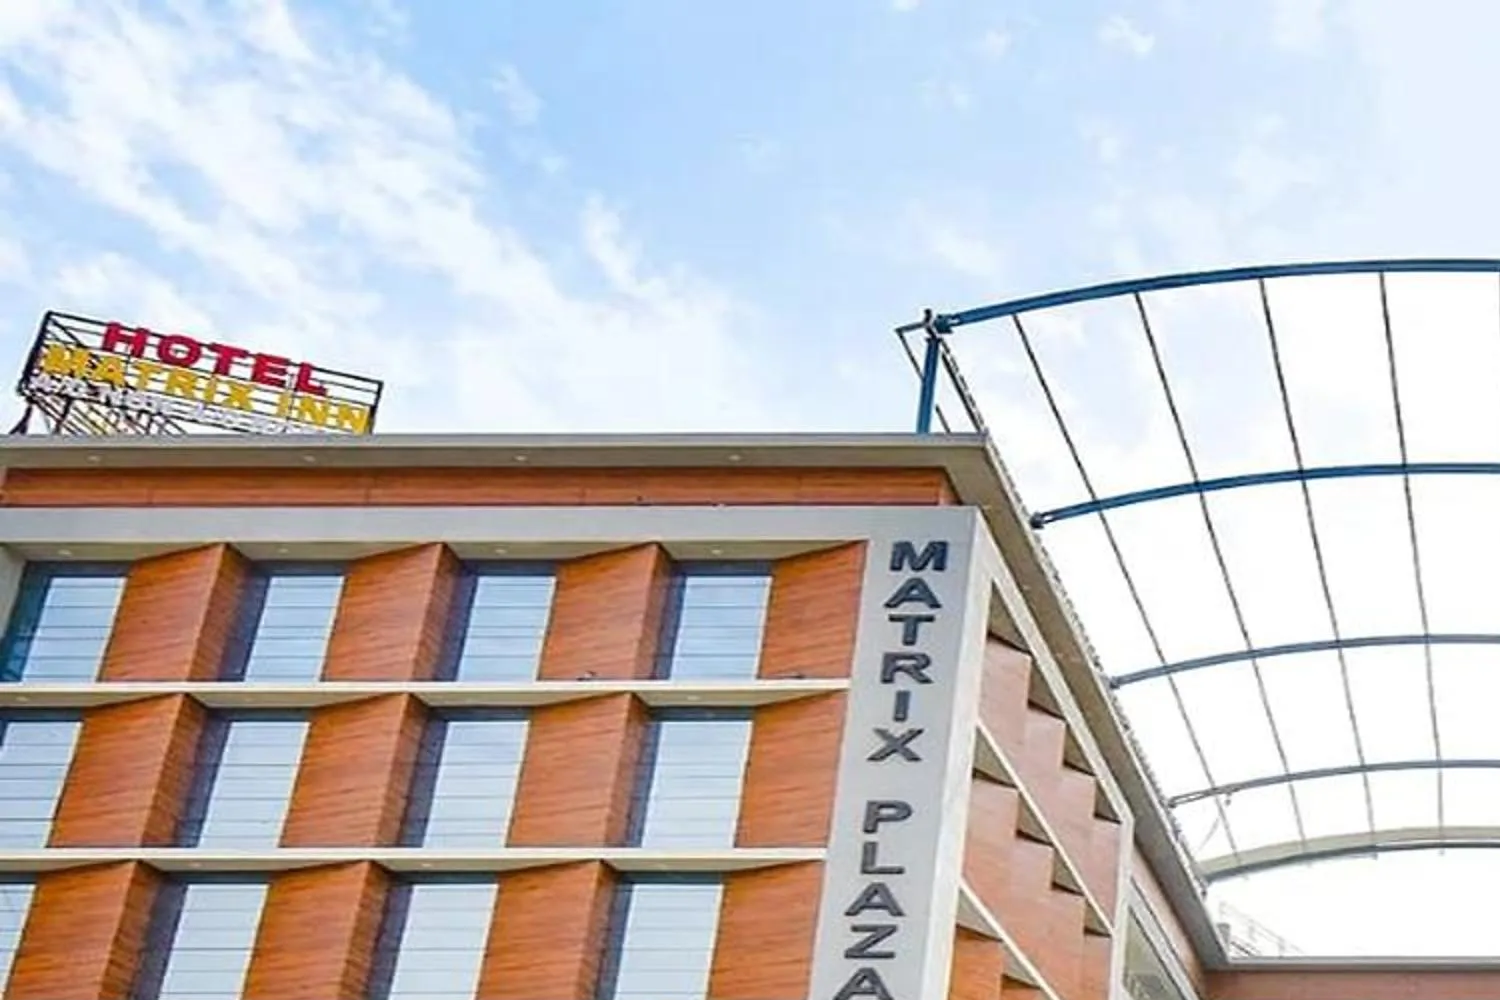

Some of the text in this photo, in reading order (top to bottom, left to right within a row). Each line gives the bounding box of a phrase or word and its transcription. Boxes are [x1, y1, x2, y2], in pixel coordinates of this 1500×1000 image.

[41, 342, 256, 409] MATRIX
[276, 391, 371, 435] INN
[101, 321, 328, 396] HOTEL
[866, 541, 949, 762] MATRIX
